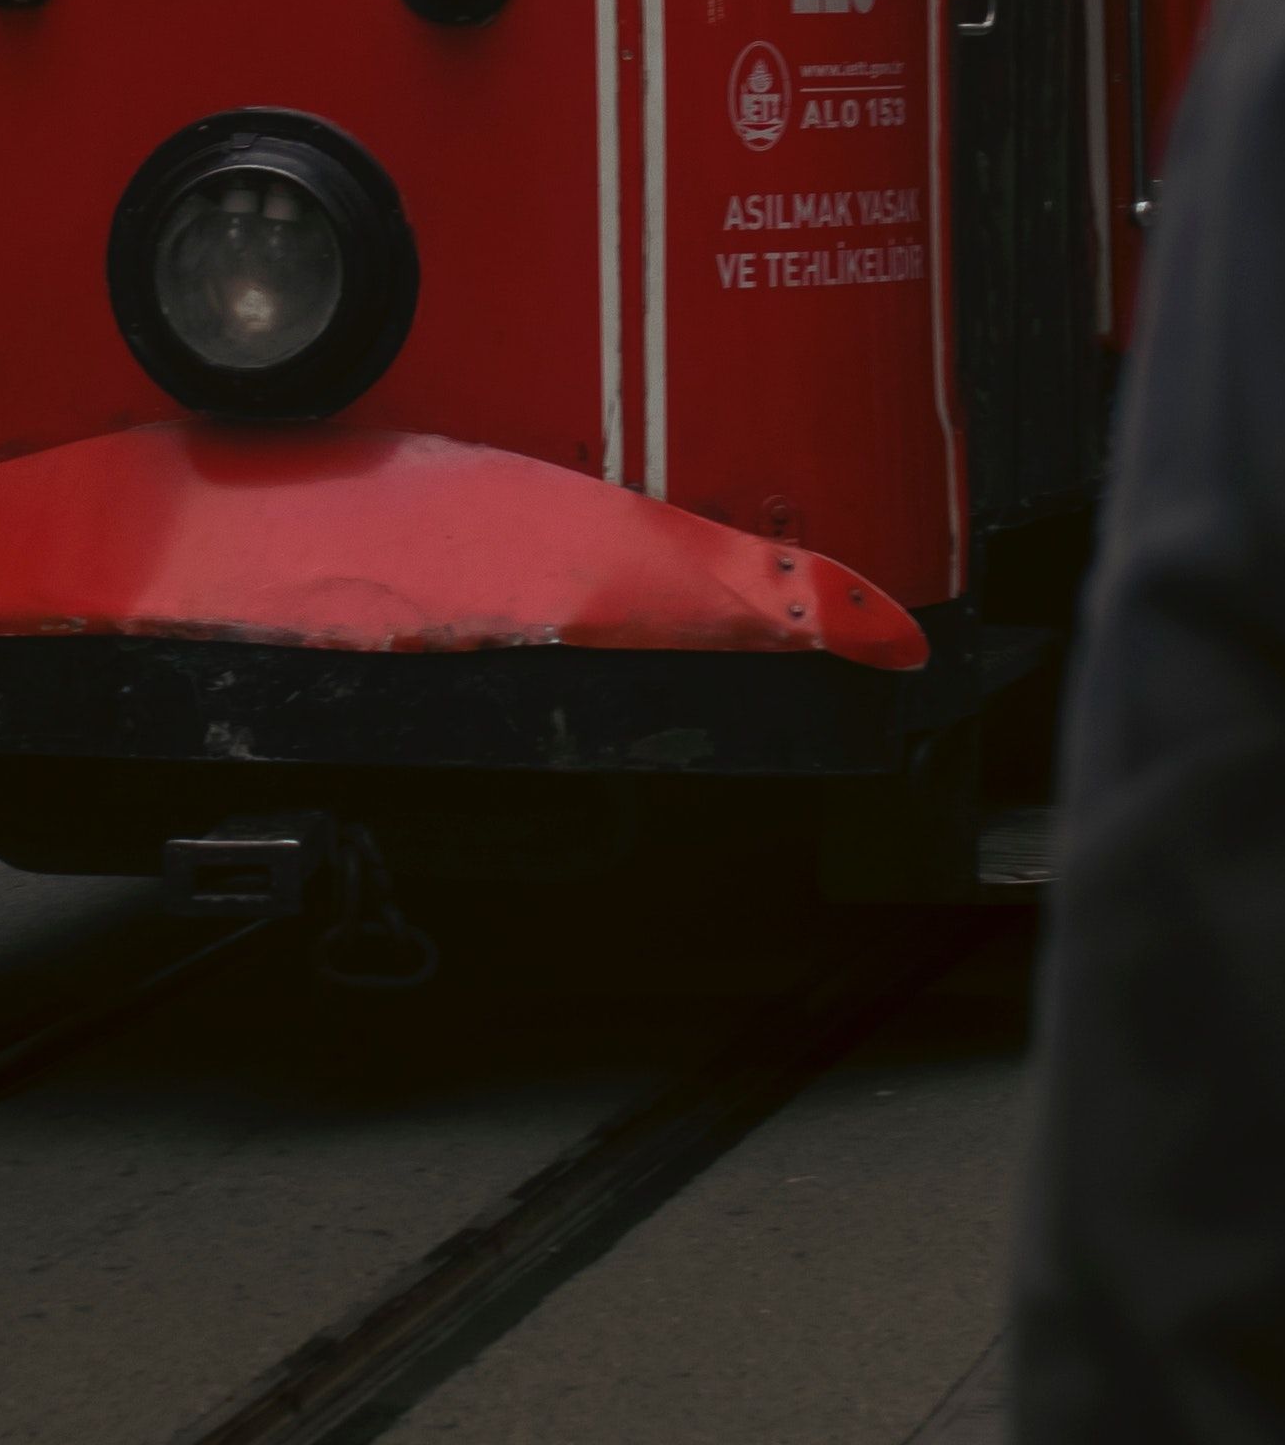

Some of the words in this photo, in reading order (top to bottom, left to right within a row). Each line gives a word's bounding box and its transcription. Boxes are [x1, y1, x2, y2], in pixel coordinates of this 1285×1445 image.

[799, 98, 861, 129] ALO
[866, 96, 907, 127] 153
[723, 192, 855, 231] ASILMAK
[715, 253, 757, 289] VE
